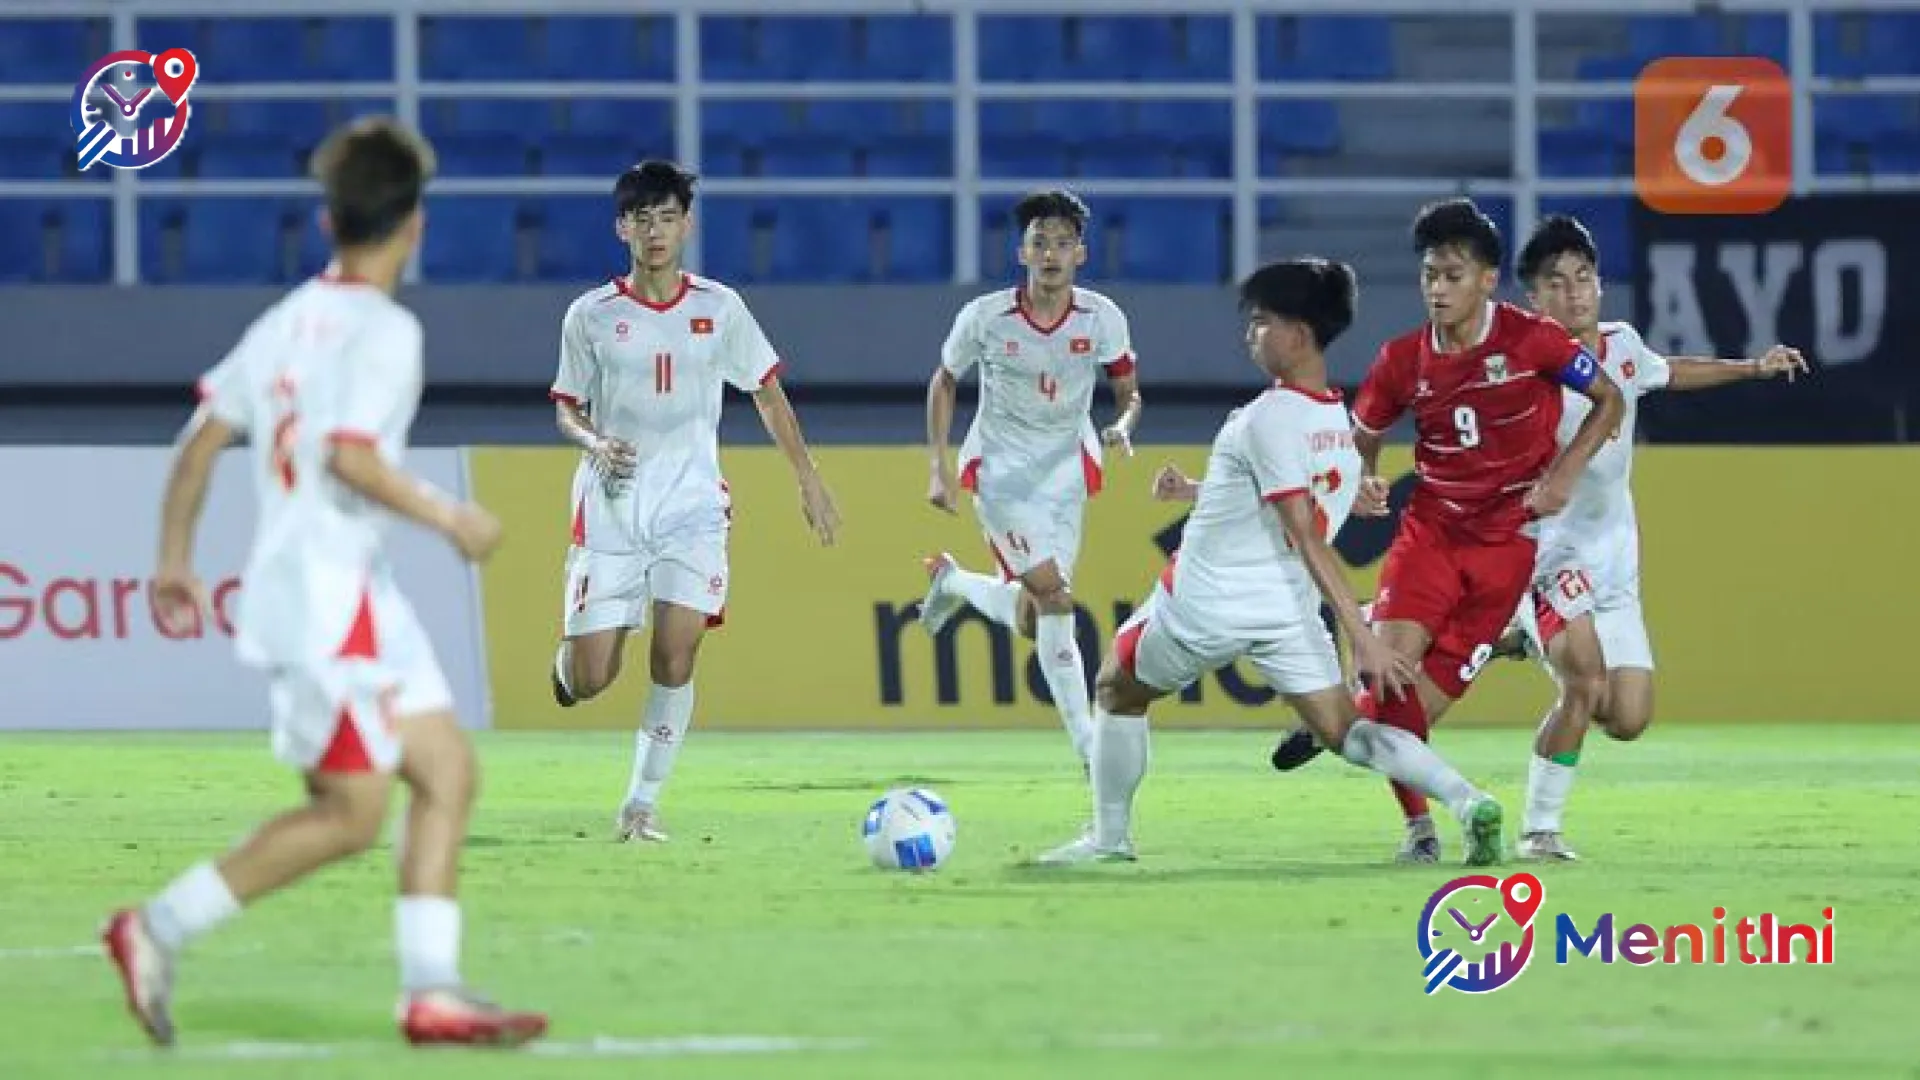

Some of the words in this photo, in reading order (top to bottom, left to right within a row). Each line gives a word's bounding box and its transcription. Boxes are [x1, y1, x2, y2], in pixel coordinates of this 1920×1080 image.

[1646, 239, 1887, 365] AYO
[655, 352, 672, 396] 11
[1038, 369, 1058, 402] 4
[1453, 405, 1482, 448] 9
[1459, 642, 1494, 682] 9
